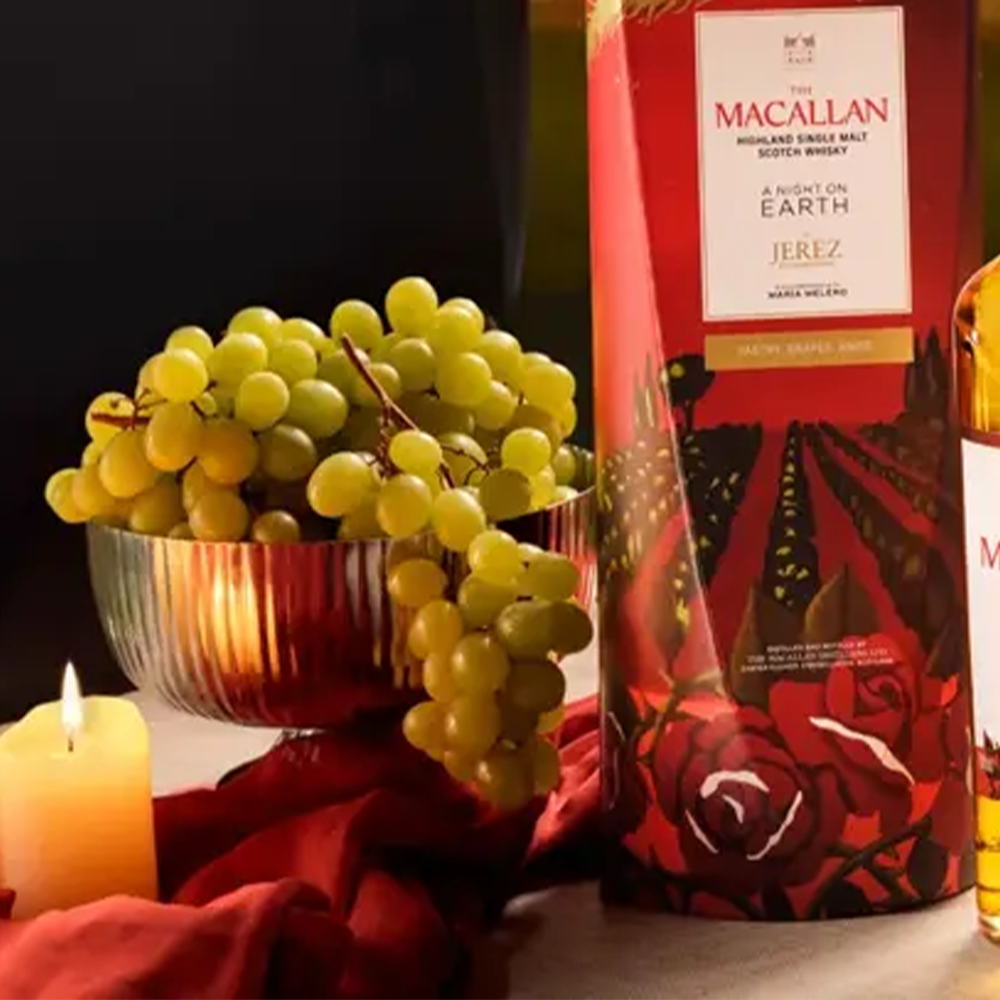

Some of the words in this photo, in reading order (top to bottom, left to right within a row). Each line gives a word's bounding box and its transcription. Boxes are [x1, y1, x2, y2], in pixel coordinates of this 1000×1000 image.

[790, 86, 812, 95] THE
[715, 97, 888, 129] MACALLAN
[737, 134, 794, 145] HIGHLAND
[797, 133, 835, 143] SINGLE
[840, 131, 867, 142] MALT
[758, 147, 801, 158] SCOTCH
[805, 146, 848, 156] WHISKY
[761, 186, 772, 196] A
[777, 184, 820, 195] NIGHT
[826, 183, 847, 193] ON
[760, 197, 849, 217] EARTH
[770, 239, 842, 265] JEREZ
